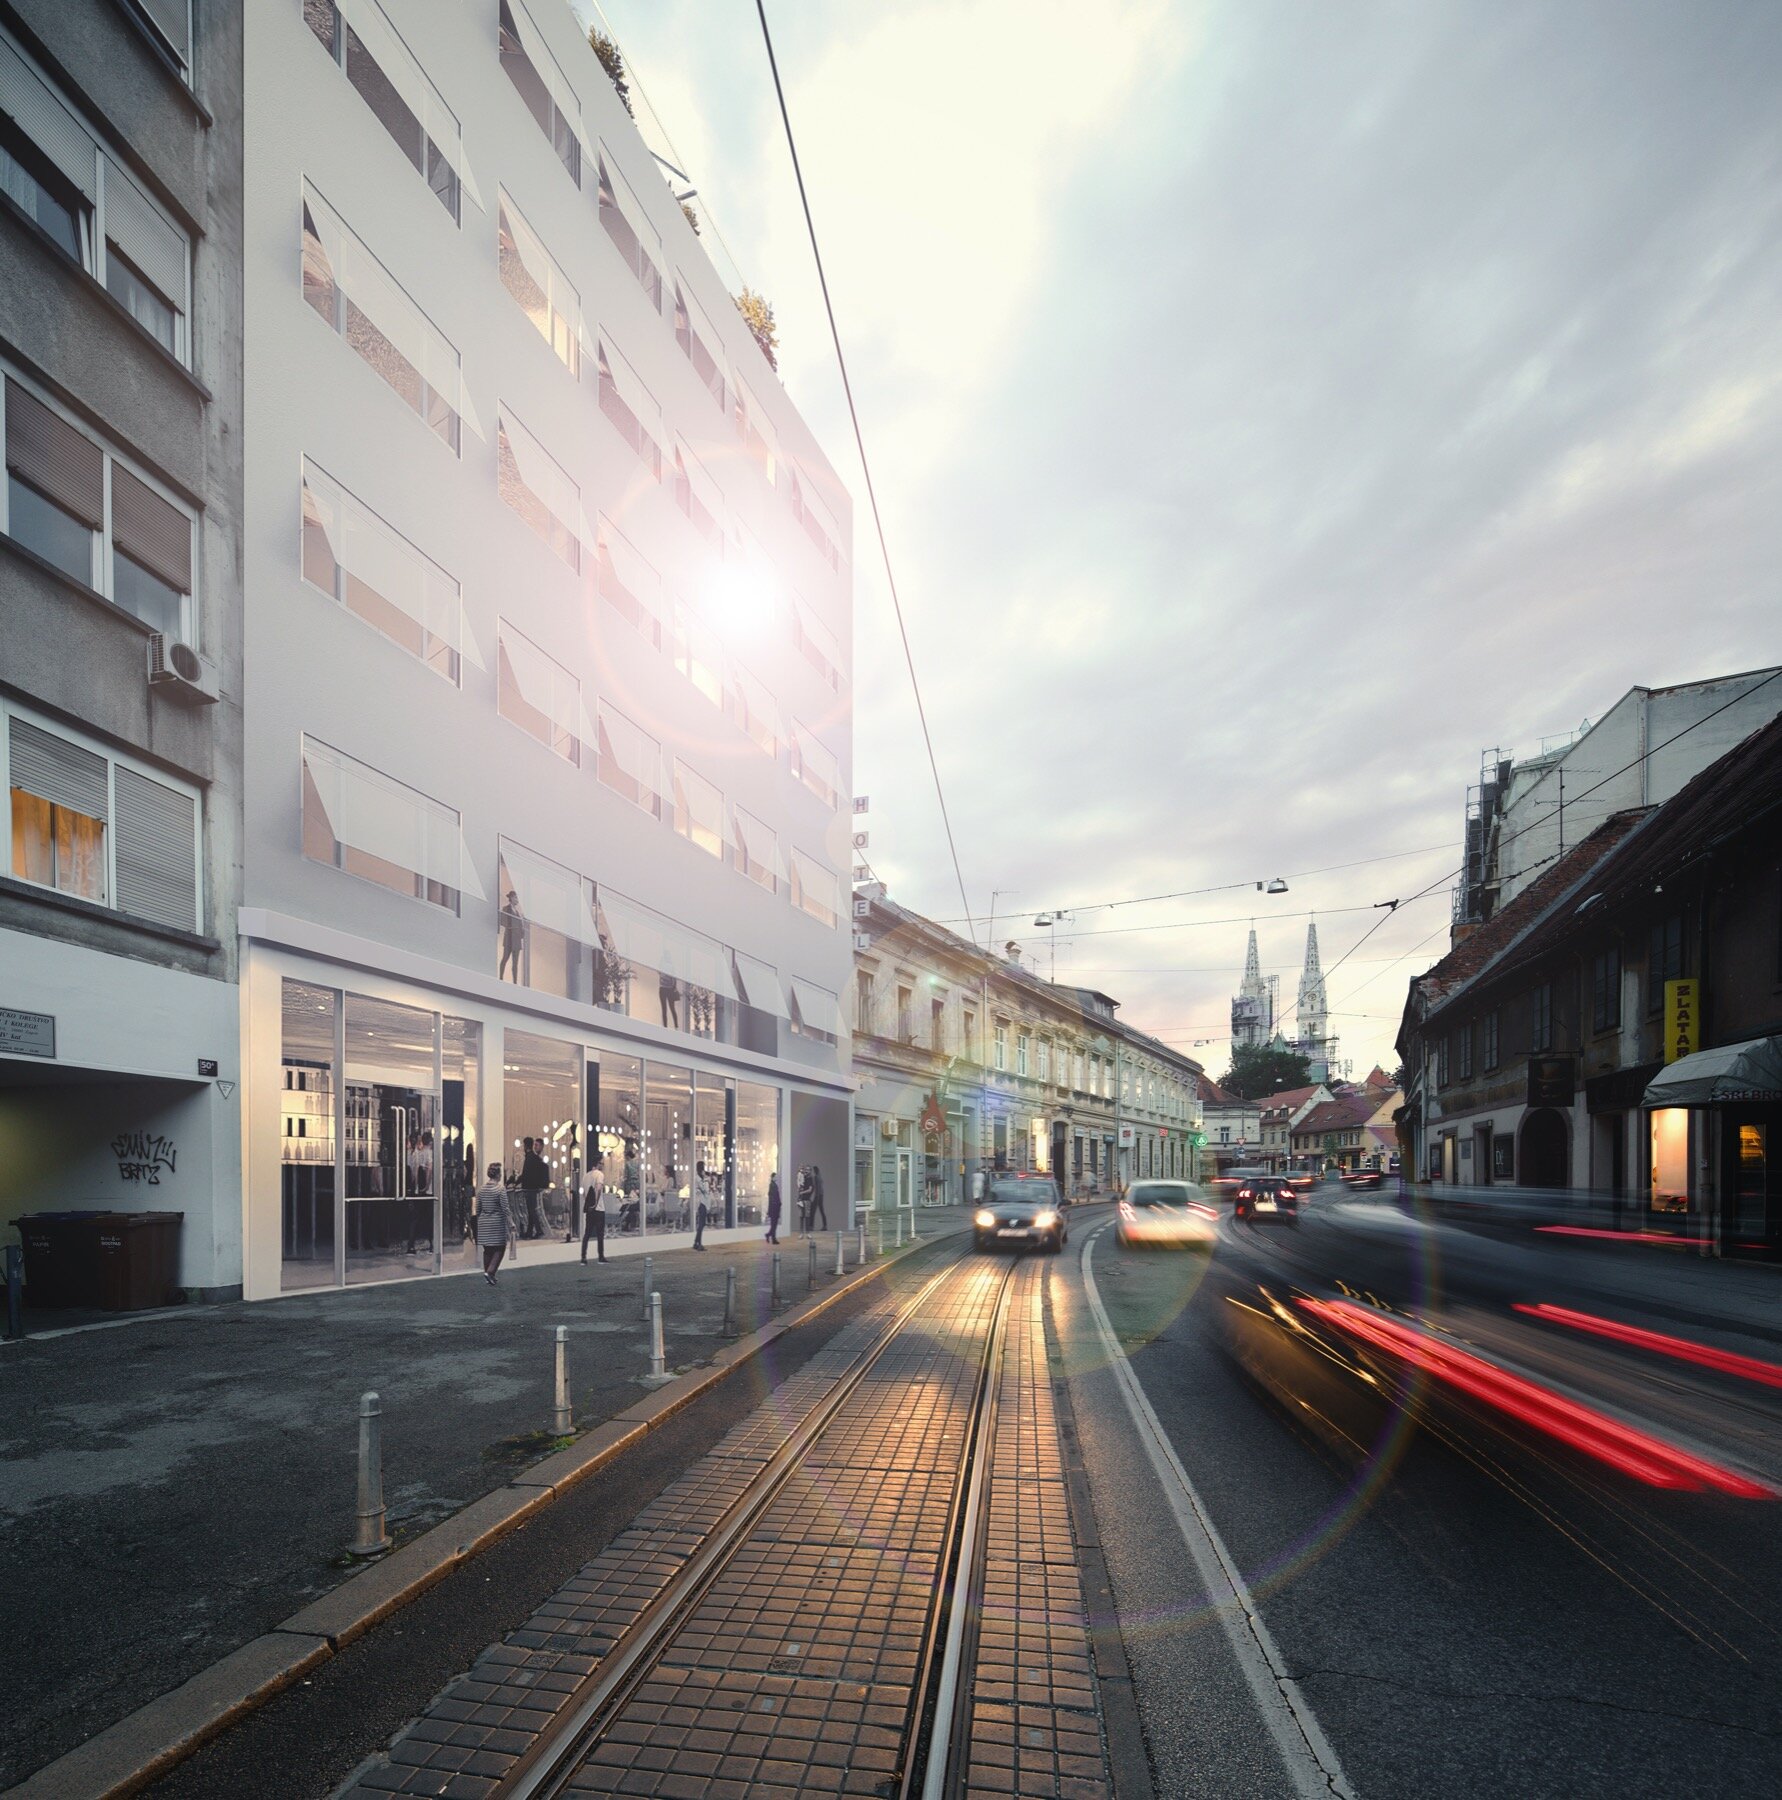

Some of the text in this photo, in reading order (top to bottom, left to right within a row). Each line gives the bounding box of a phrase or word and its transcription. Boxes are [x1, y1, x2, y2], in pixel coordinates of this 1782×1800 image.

[855, 798, 867, 949] HOTEL
[11, 1021, 39, 1029] KOLEGE
[1677, 985, 1690, 1058] ZLATAR
